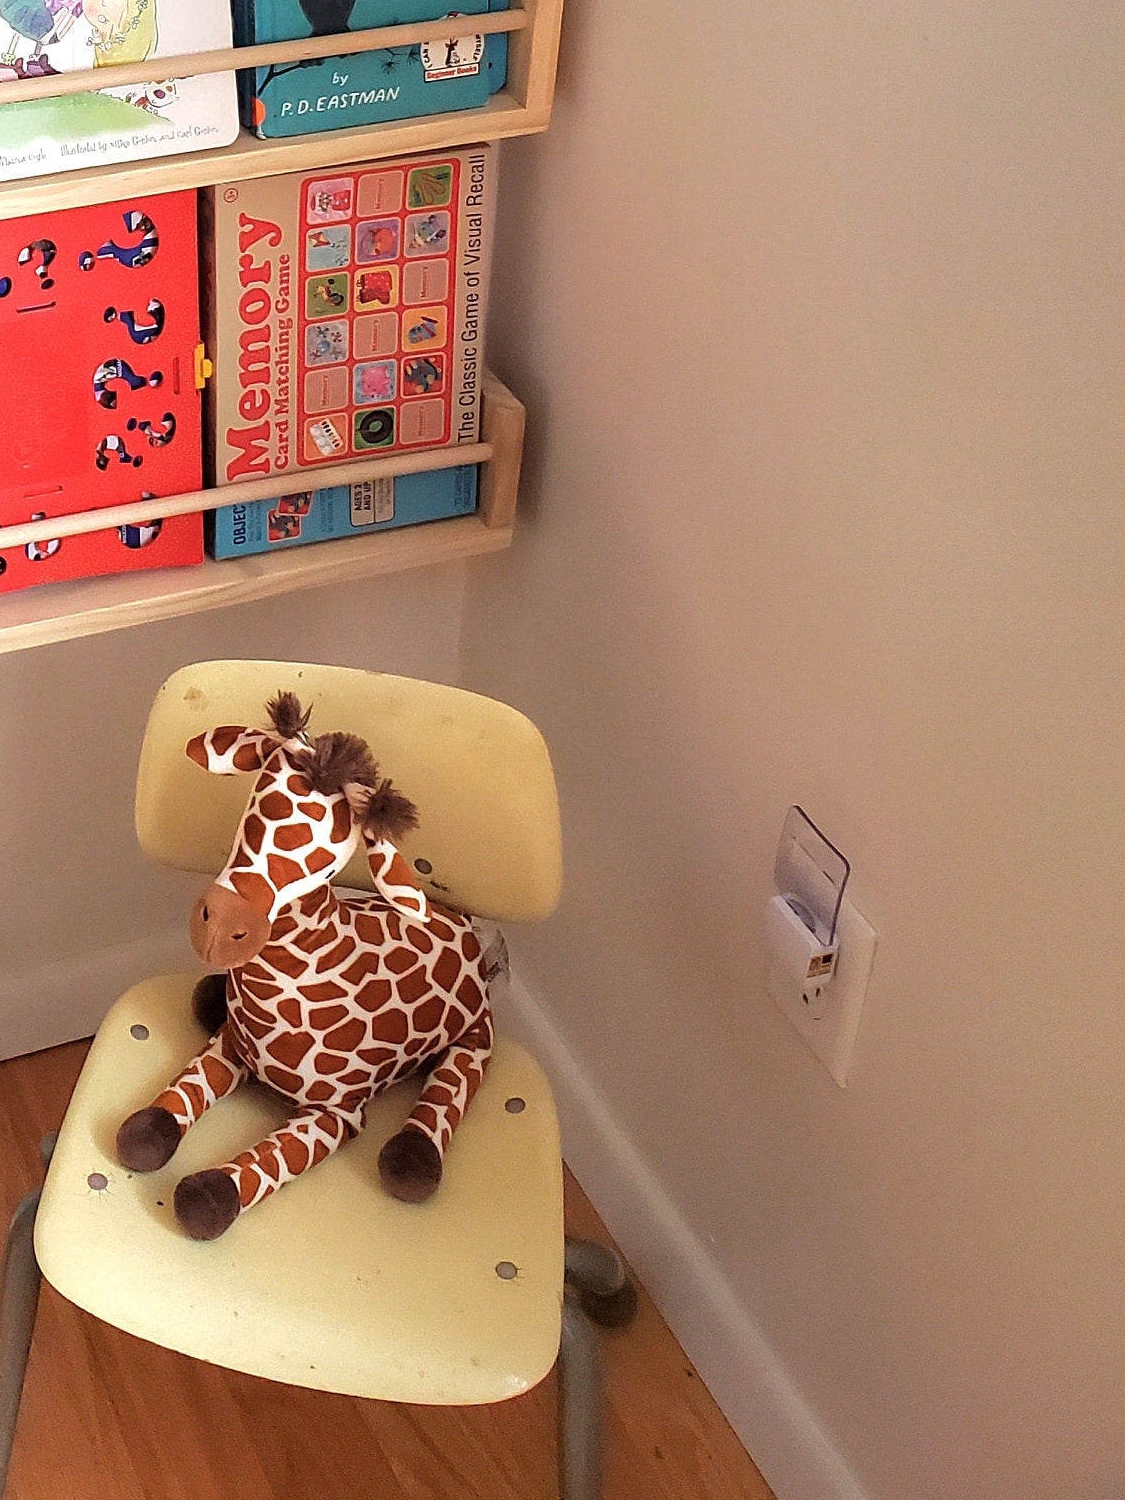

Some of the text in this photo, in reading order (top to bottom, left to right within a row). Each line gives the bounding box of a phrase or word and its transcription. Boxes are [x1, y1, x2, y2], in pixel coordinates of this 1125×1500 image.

[332, 73, 349, 87] by
[426, 66, 477, 79] Beginner Books
[226, 212, 283, 482] Memory
[274, 253, 293, 470] Card Matching Game
[458, 154, 485, 442] The Classic Game of Visual Recall
